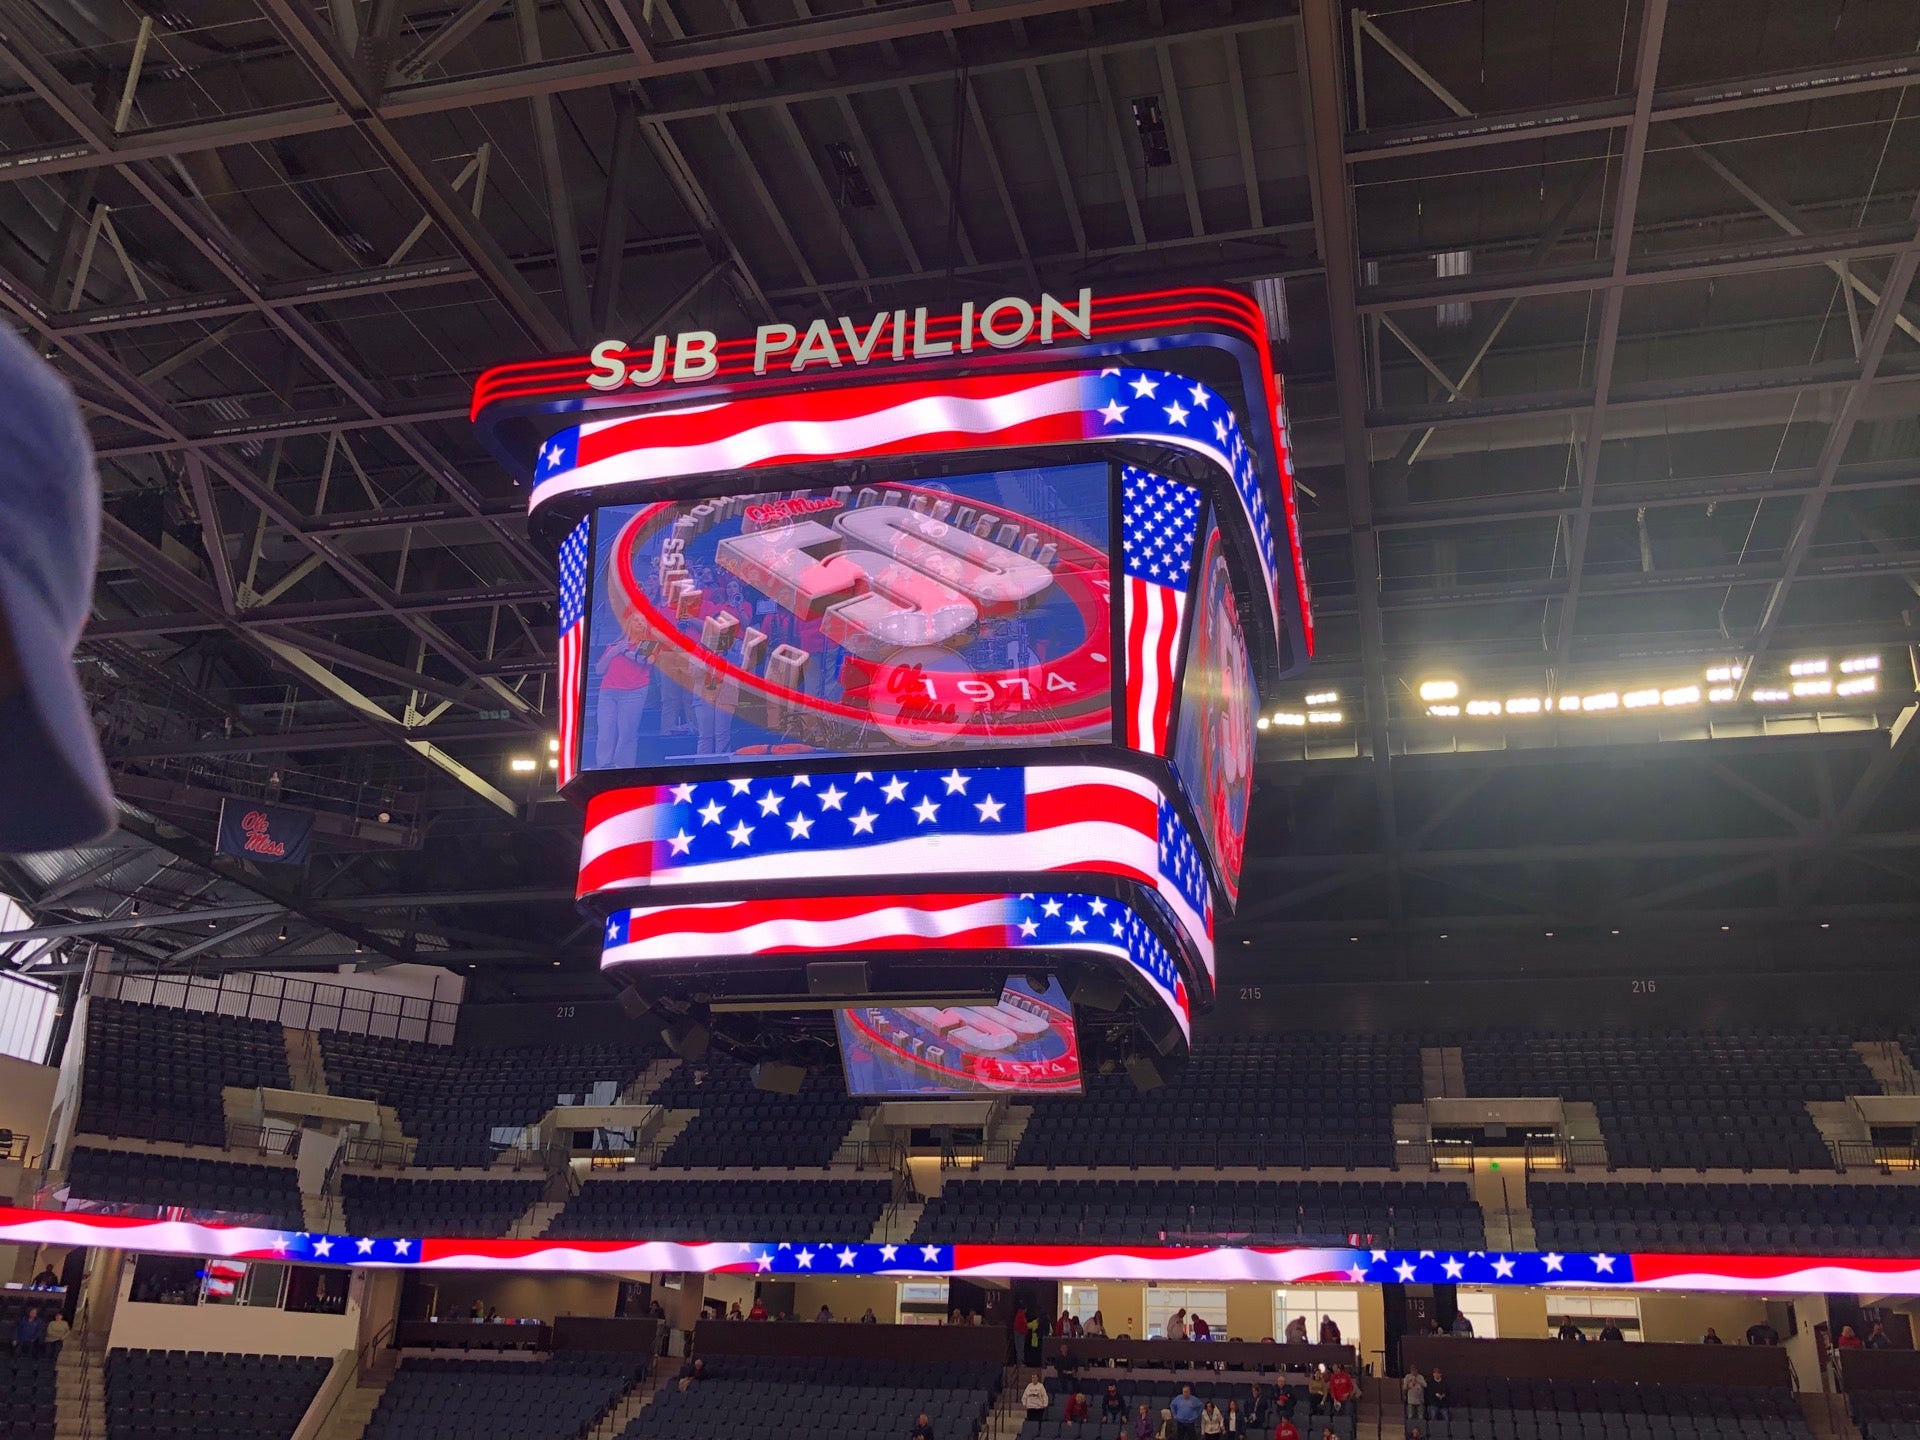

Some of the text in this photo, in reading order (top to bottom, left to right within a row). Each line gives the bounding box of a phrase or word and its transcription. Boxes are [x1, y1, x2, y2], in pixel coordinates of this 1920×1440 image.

[585, 287, 1092, 391] SJB PAVILION
[920, 671, 1078, 703] 1974
[241, 811, 270, 832] Ole
[244, 830, 285, 857] Miss
[1631, 980, 1656, 993] 216
[1240, 987, 1262, 1000] 215
[556, 1006, 575, 1018] 213
[997, 1063, 1067, 1076] 1974
[1407, 1299, 1425, 1311] 113
